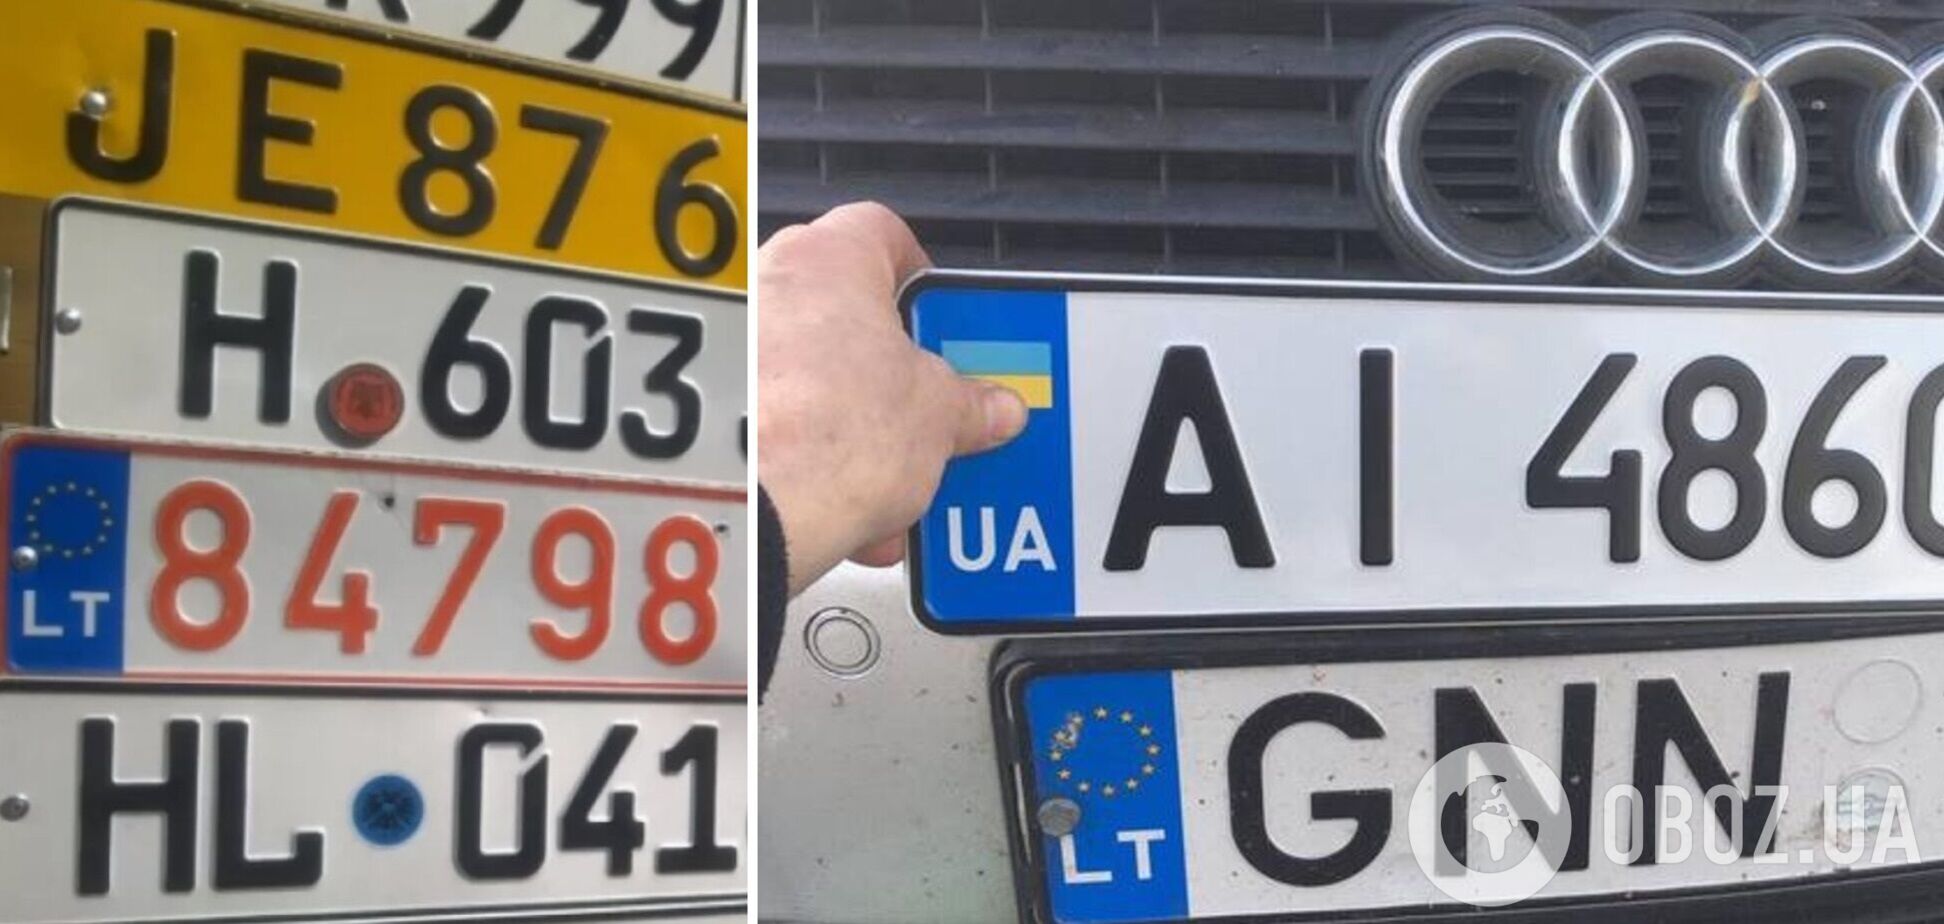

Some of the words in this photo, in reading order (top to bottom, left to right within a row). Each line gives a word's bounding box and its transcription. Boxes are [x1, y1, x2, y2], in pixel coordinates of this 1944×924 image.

[150, 478, 720, 665] 84798
[947, 506, 1057, 572] UA
[22, 589, 111, 637] LT
[77, 716, 325, 896] HL
[1227, 670, 1792, 889] GNN
[1060, 828, 1166, 884] LT
